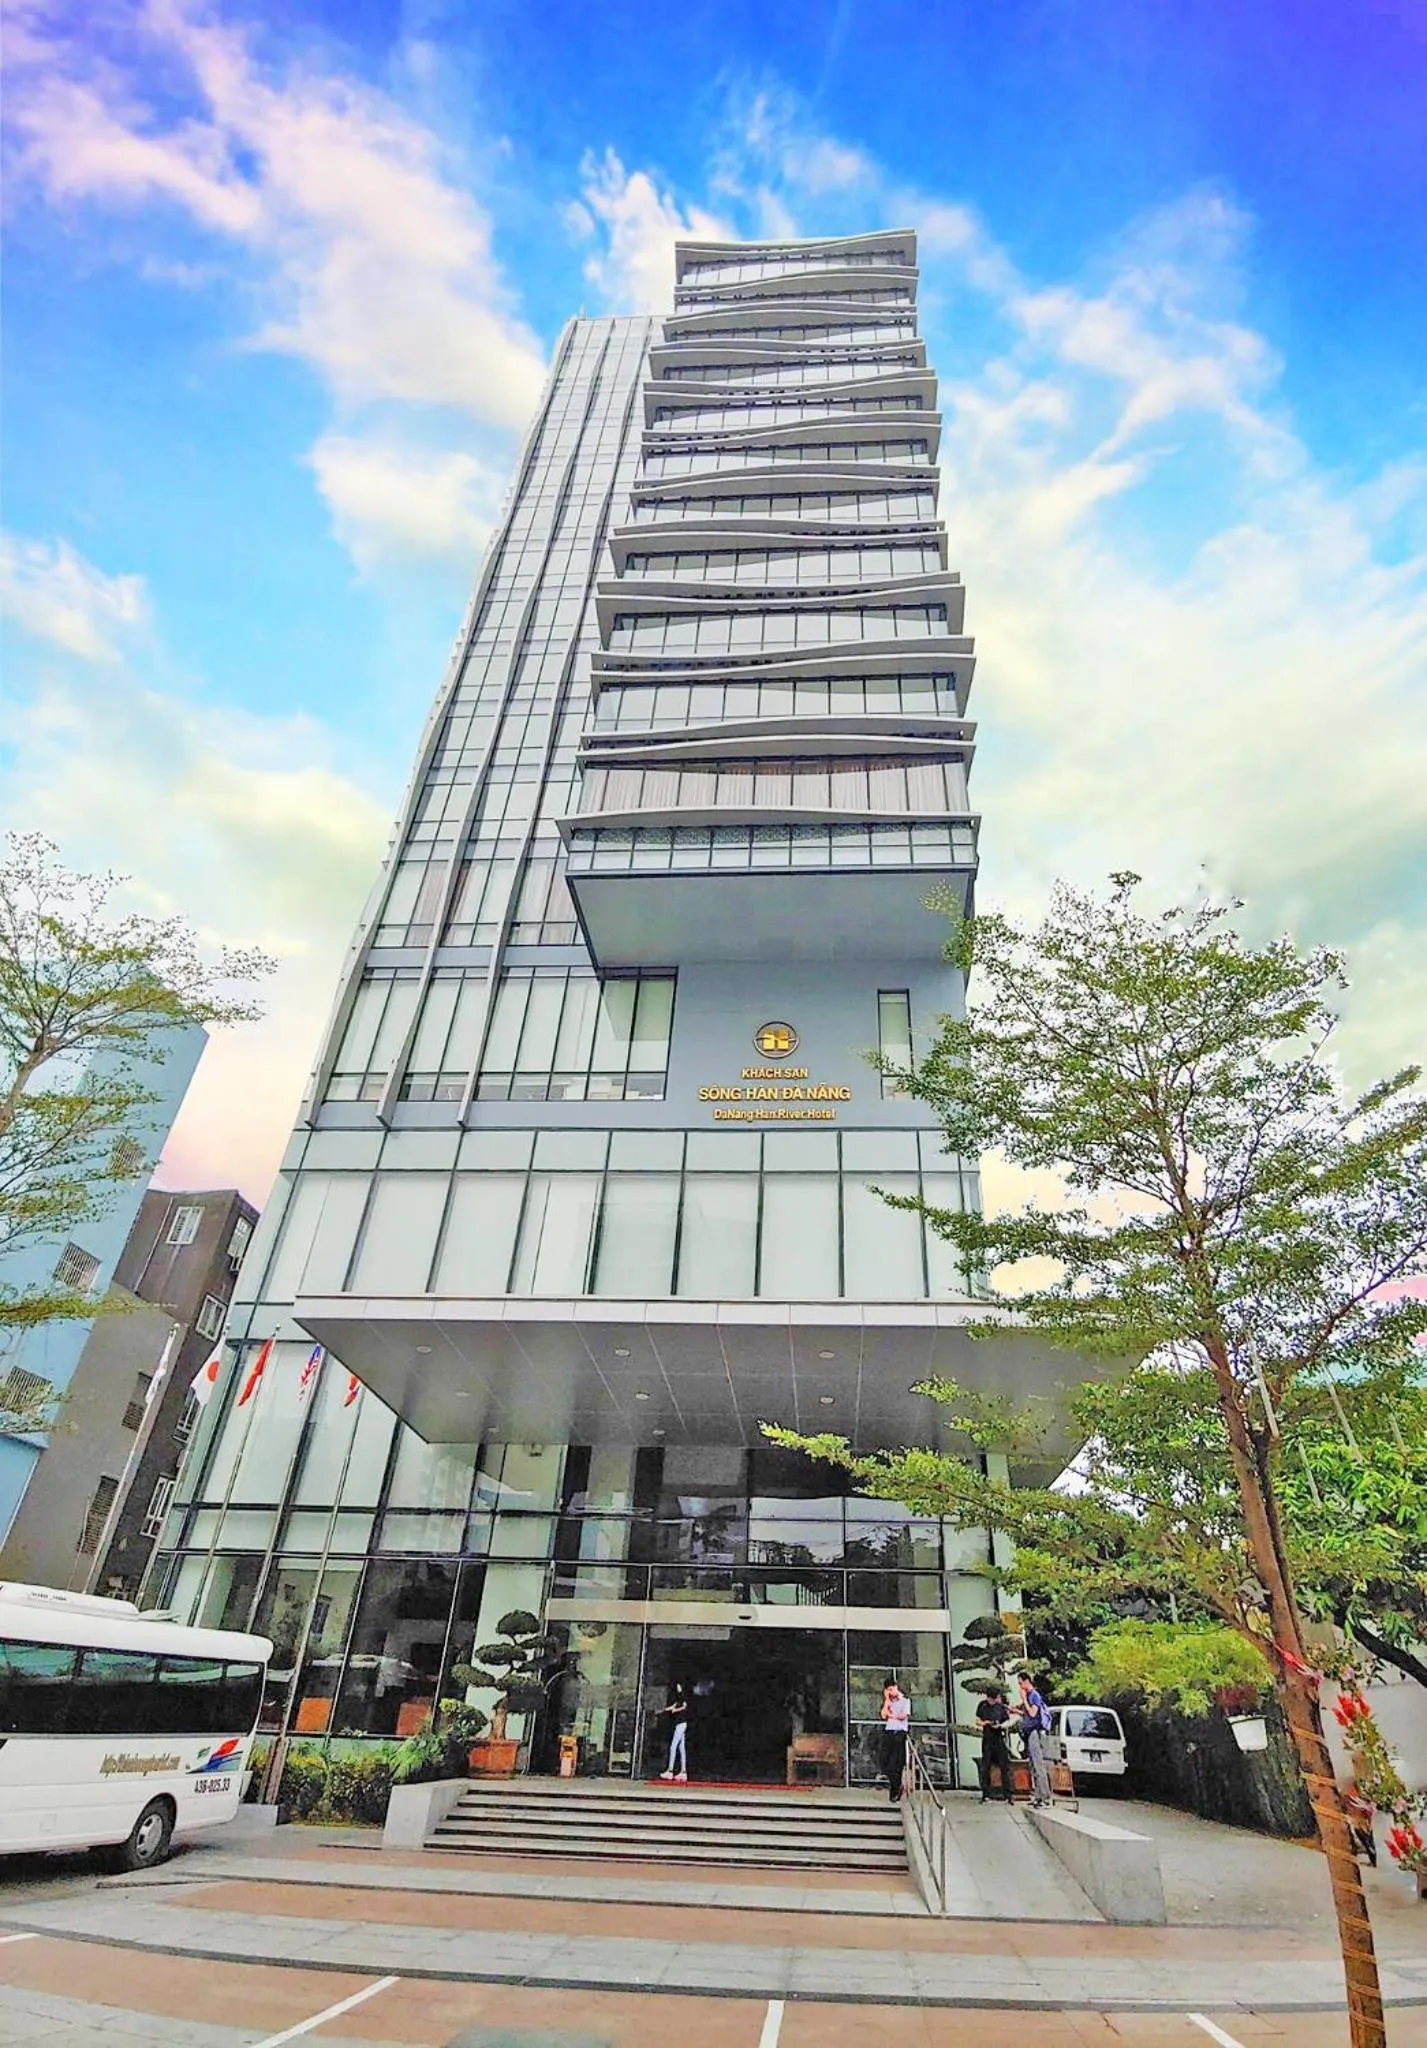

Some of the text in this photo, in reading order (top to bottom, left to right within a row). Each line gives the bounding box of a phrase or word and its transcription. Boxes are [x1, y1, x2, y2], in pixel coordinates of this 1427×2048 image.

[742, 1067, 809, 1080] KHÁCH SẠN
[699, 1084, 742, 1101] SÔNG
[746, 1084, 778, 1101] HÀN
[783, 1084, 803, 1101] ĐÀ
[756, 1108, 777, 1120] Han
[778, 1108, 805, 1120] River
[808, 1108, 836, 1120] Hotel
